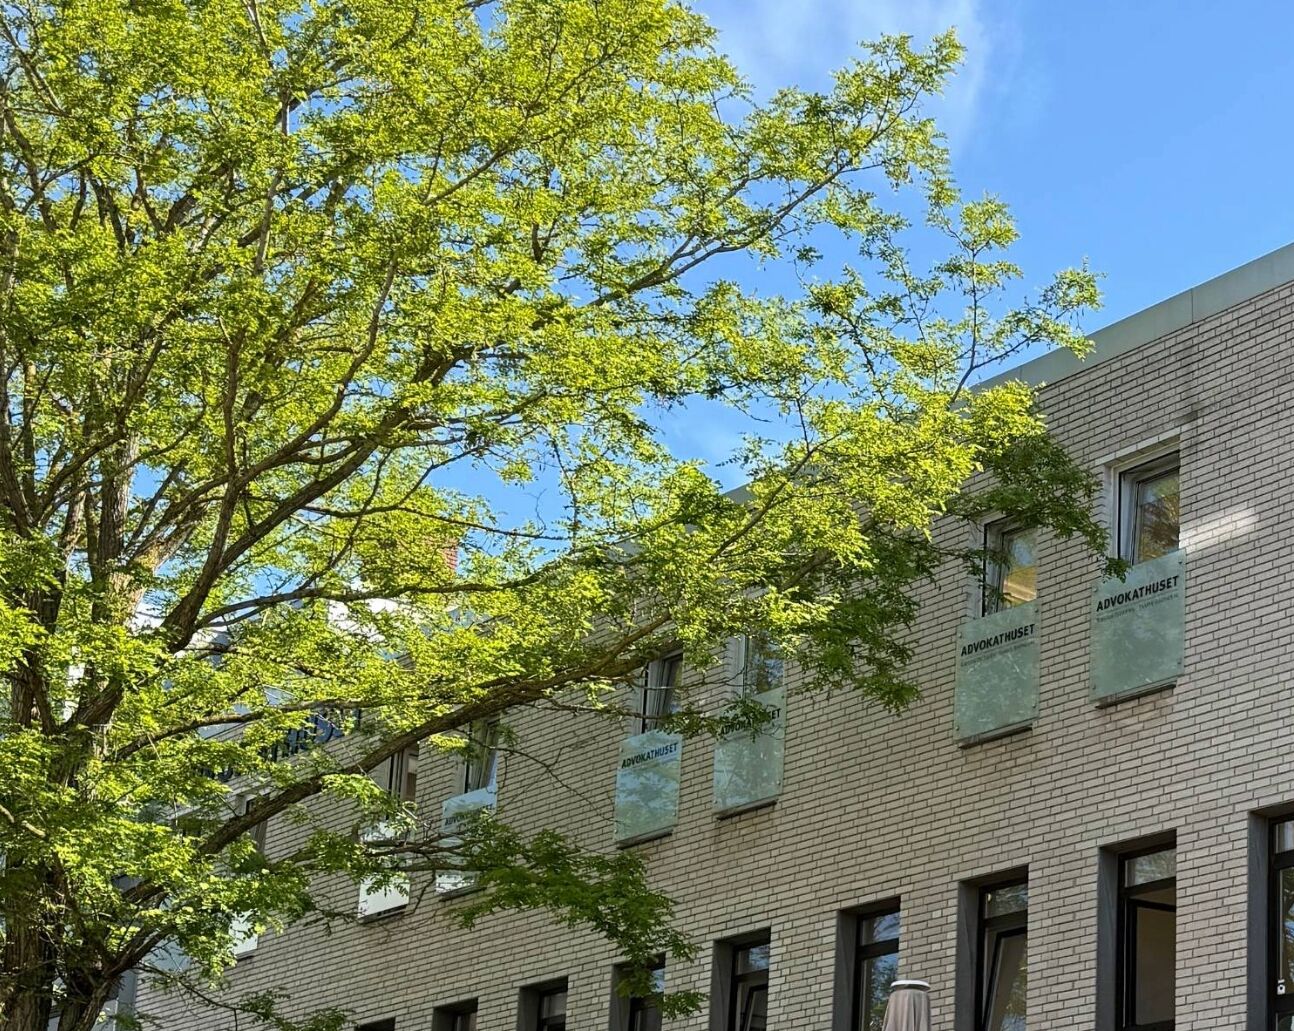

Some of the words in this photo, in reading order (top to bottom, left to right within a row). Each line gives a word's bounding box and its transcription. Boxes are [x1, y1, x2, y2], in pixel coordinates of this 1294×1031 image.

[1096, 575, 1179, 612] ADVOKATHUSET
[960, 623, 1035, 656] ADVOKATHUSET
[621, 742, 679, 769] ADVOKATHUSET
